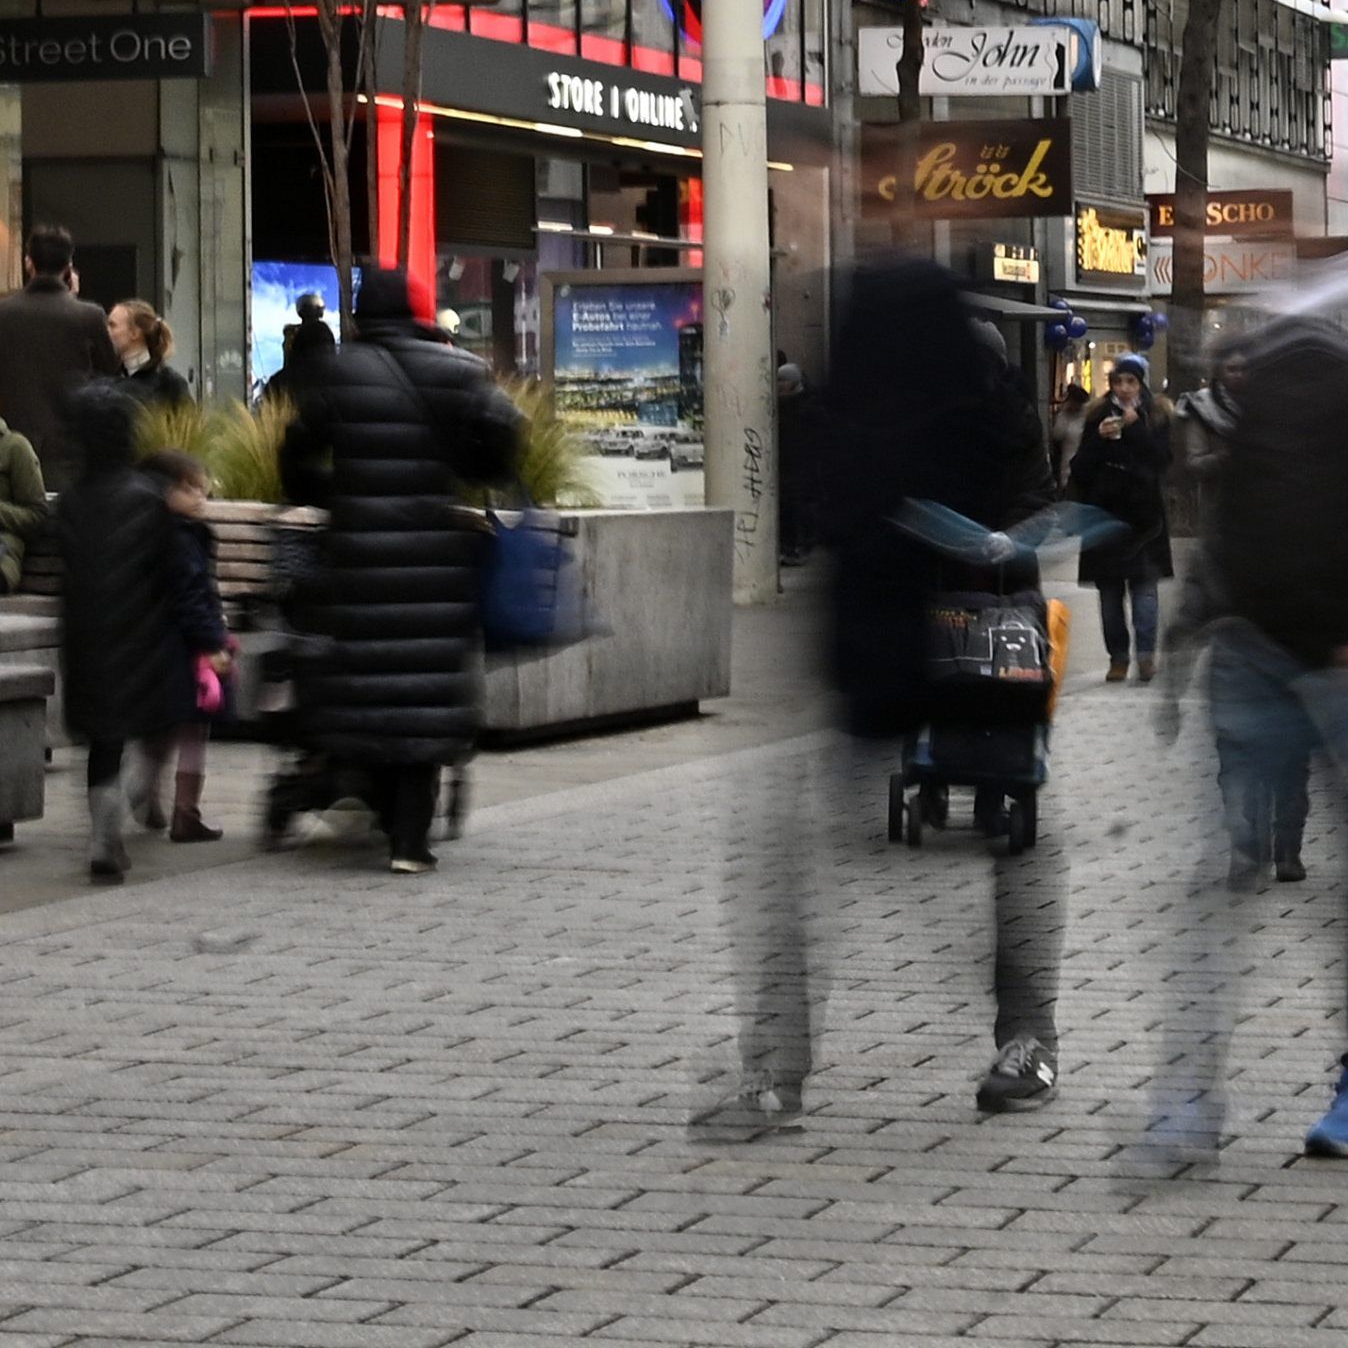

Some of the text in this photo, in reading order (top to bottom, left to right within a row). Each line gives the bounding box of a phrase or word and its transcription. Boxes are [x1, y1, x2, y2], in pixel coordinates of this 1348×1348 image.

[110, 30, 192, 63] One
[931, 30, 1041, 82] John
[547, 71, 604, 117] STORE
[624, 87, 684, 131] ONLINE
[1158, 202, 1275, 227] ESCHO
